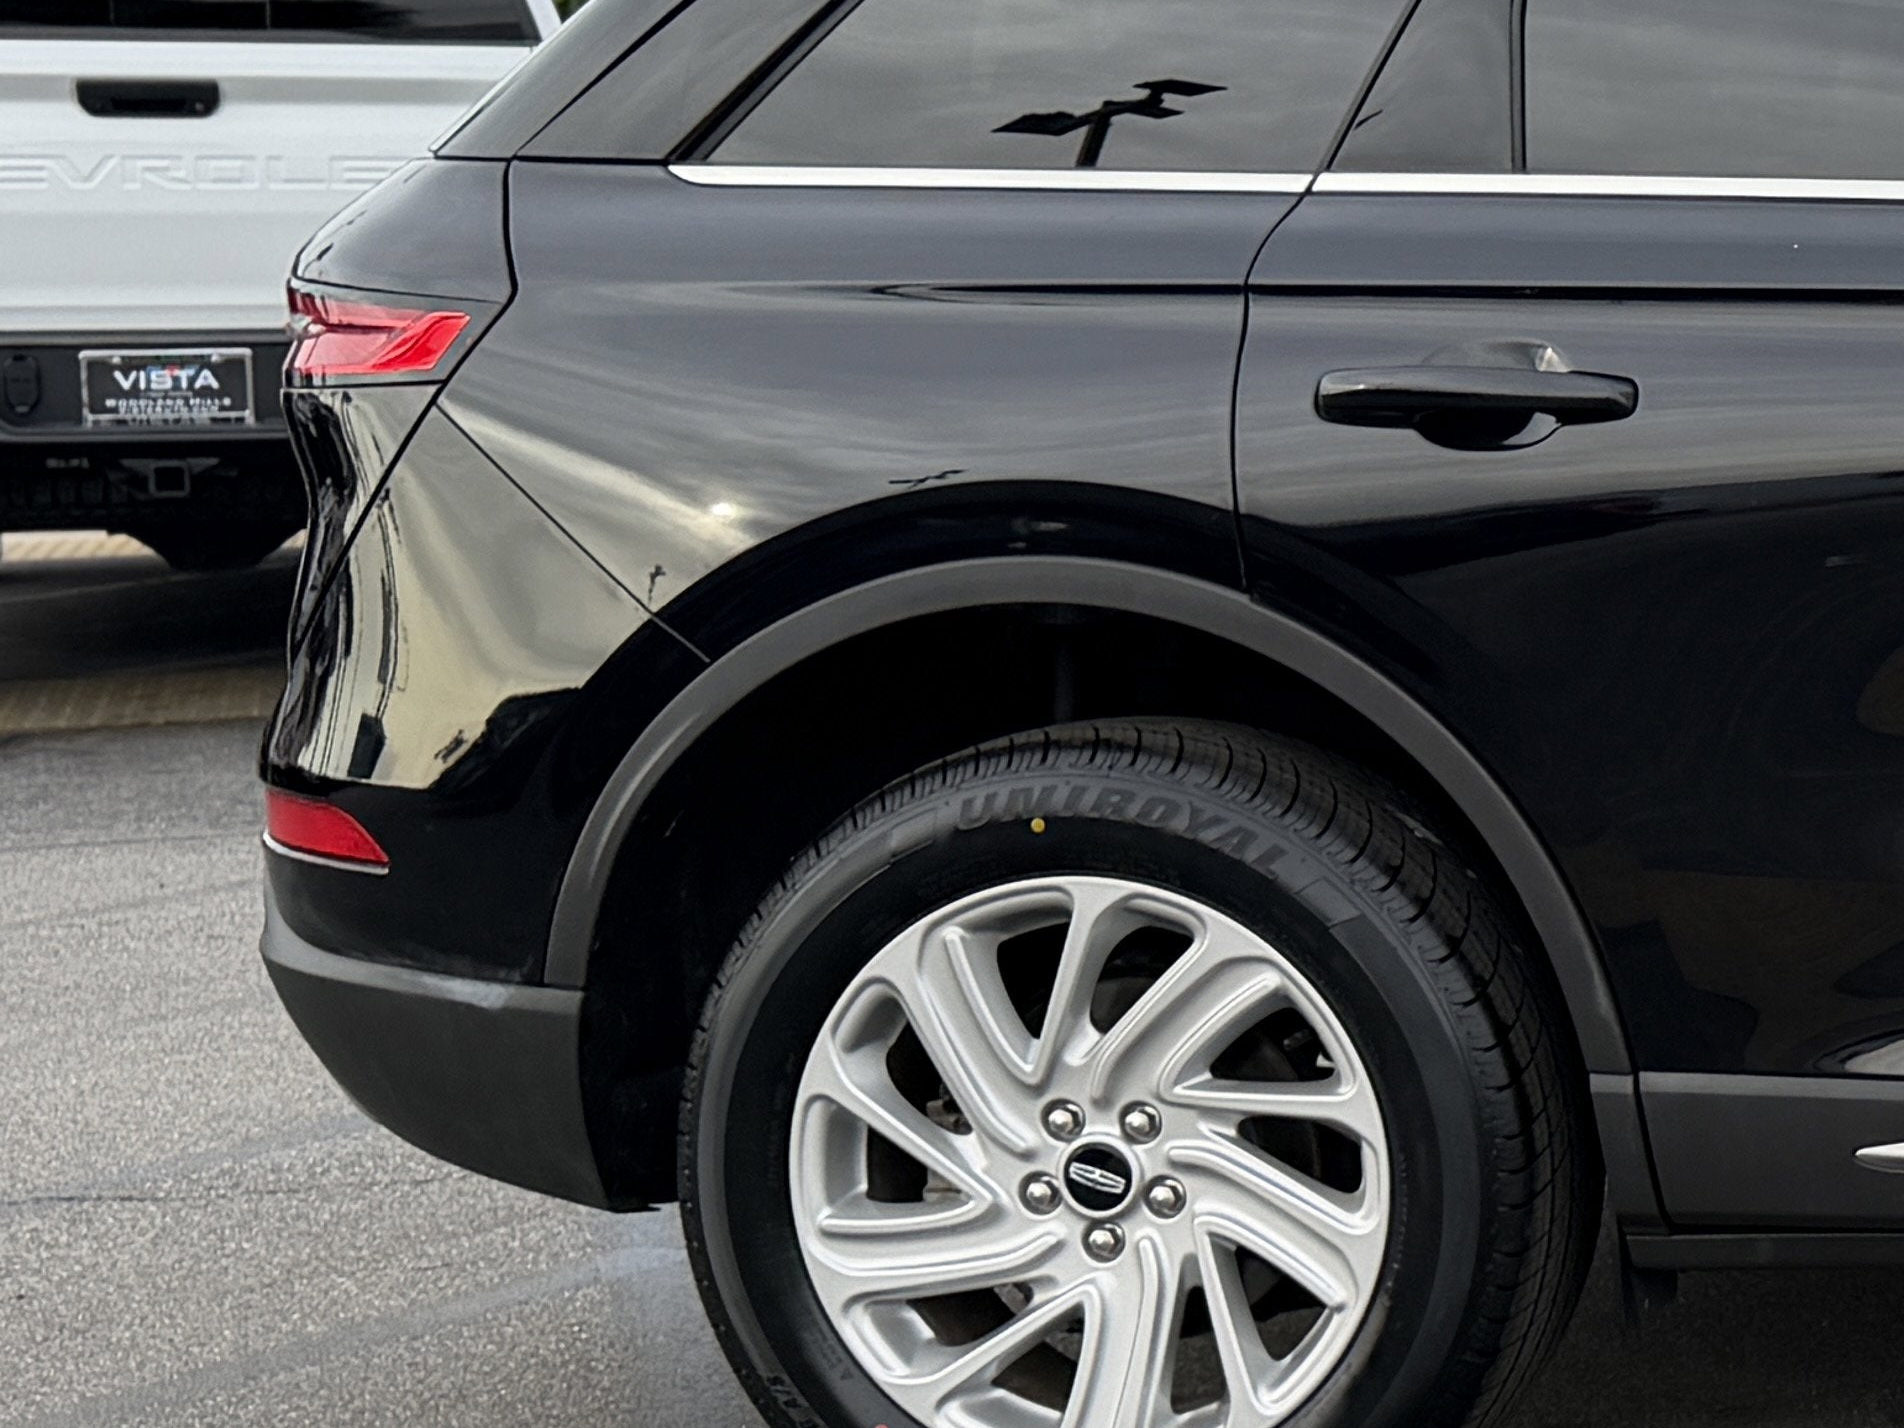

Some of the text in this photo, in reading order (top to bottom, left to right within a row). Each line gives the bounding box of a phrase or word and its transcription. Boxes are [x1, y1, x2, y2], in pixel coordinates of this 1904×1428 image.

[0, 154, 398, 191] EVROLE
[112, 368, 220, 391] VISTA
[956, 784, 1291, 881] UNIROYAL
